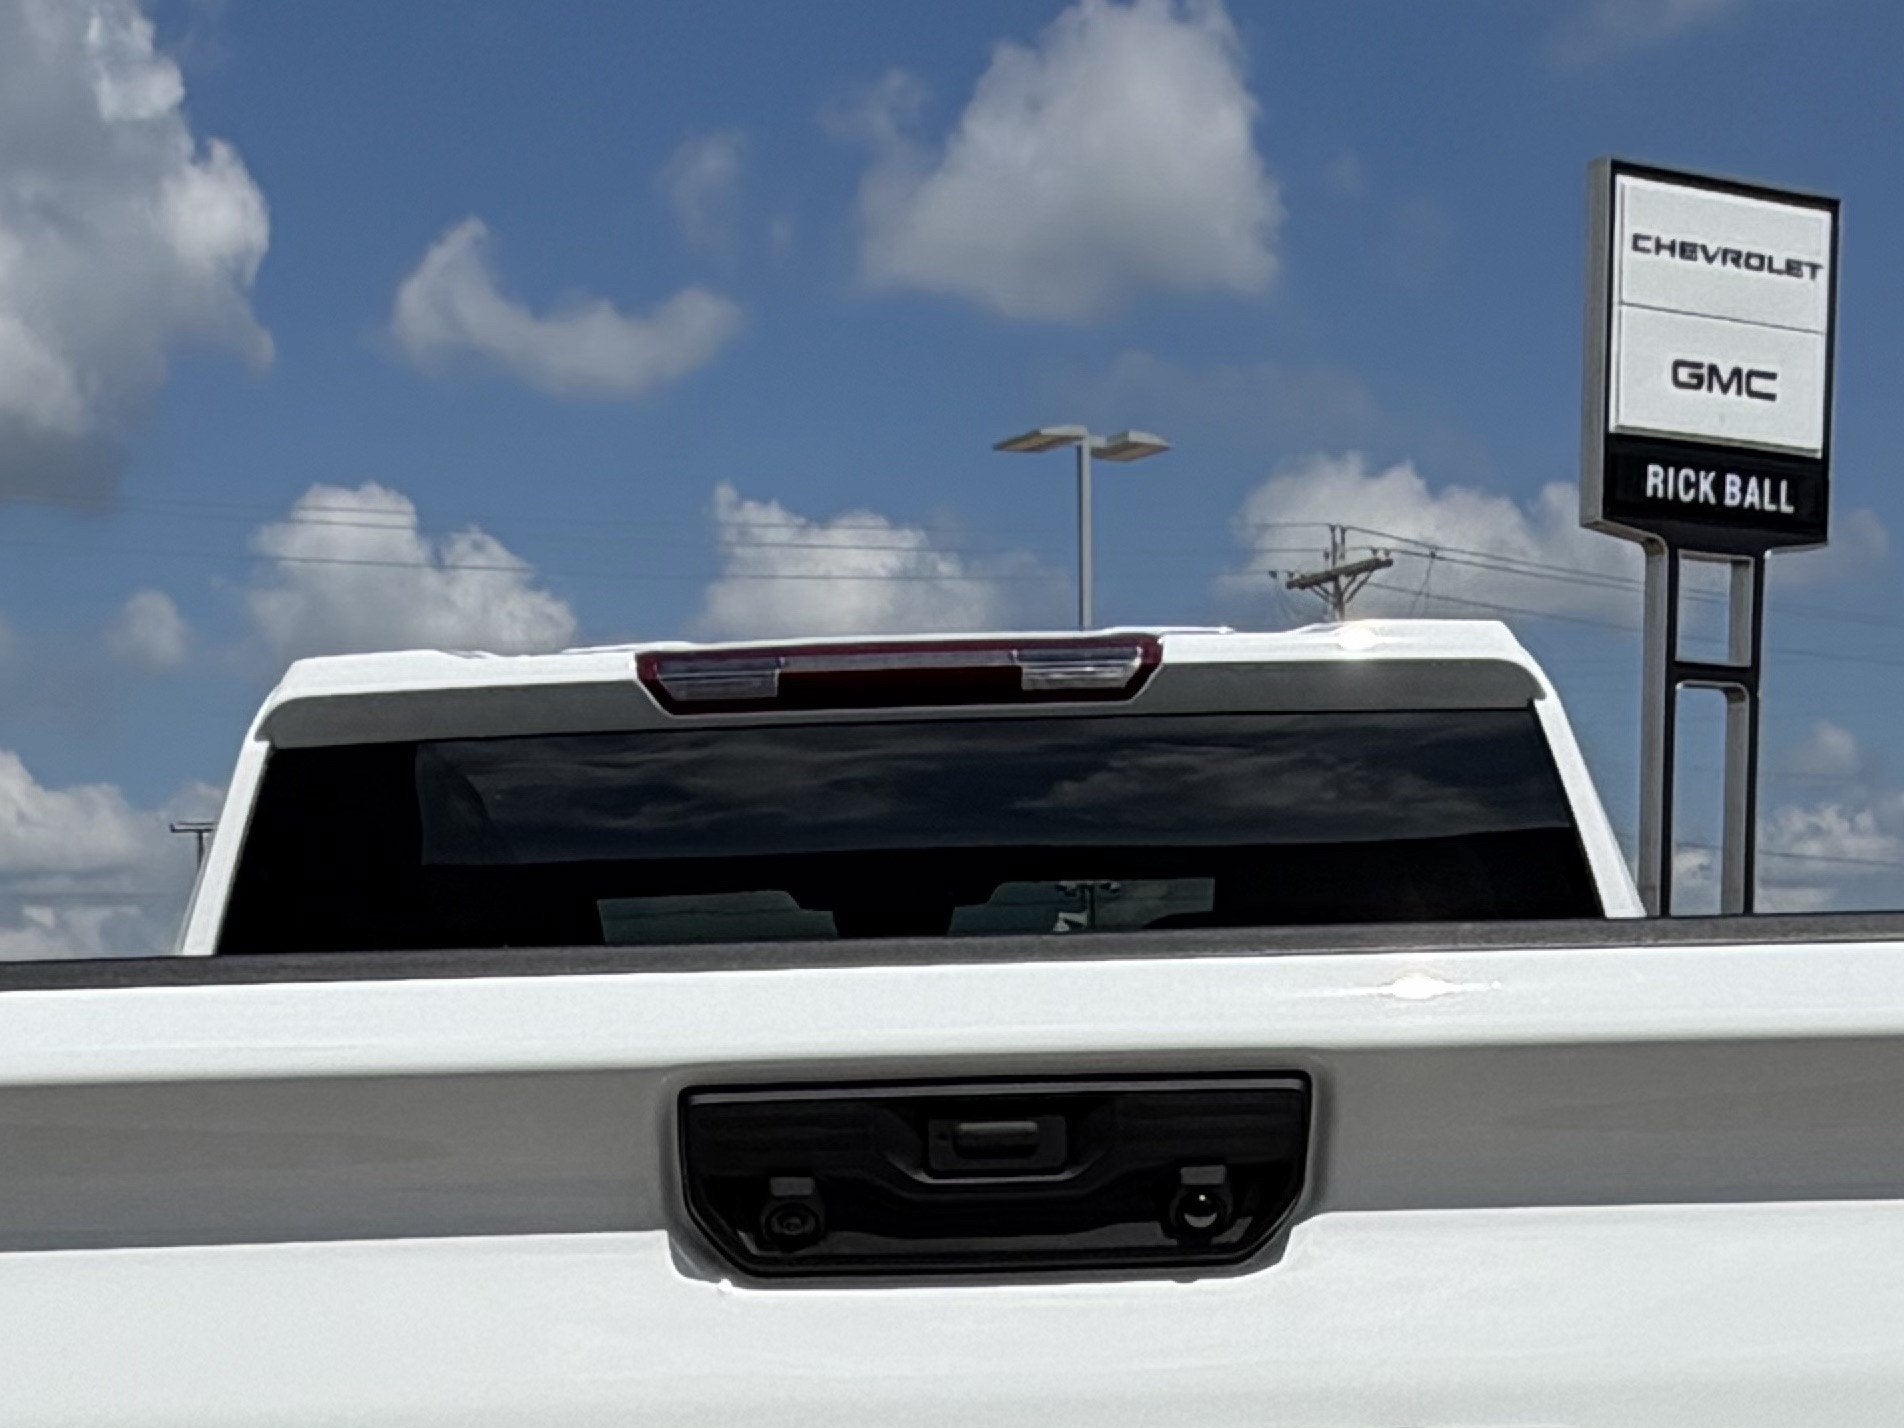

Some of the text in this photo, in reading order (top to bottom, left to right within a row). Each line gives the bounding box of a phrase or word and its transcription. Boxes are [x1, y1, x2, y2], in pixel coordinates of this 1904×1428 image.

[1630, 232, 1824, 281] CHEVROLET
[1670, 358, 1778, 402] GMC
[1645, 463, 1795, 514] RICK BALL
